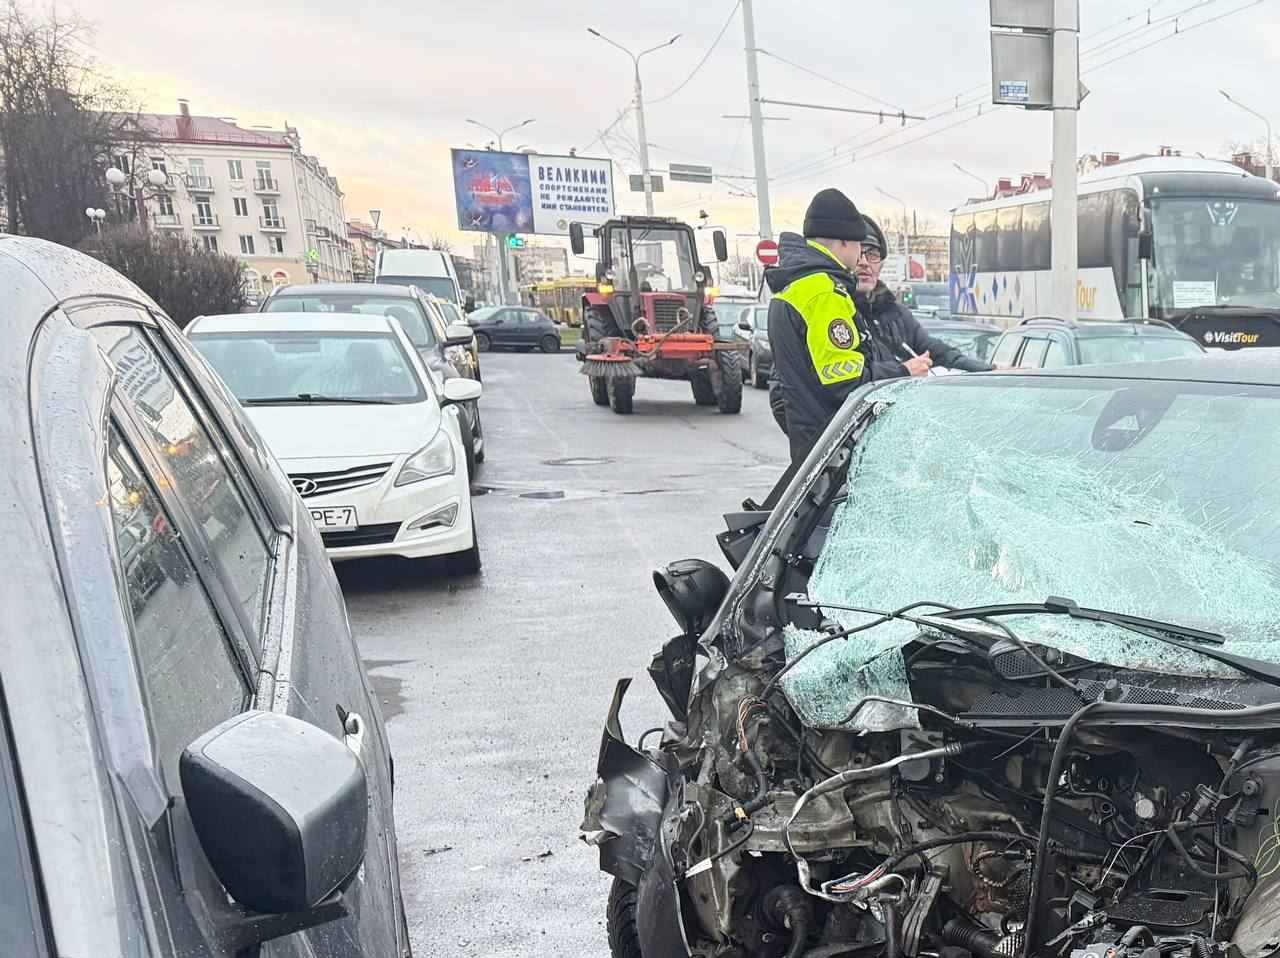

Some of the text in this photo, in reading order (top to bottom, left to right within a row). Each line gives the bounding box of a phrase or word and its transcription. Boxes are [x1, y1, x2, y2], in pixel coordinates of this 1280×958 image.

[538, 166, 606, 185] ВЕЛИКИМИ
[539, 183, 607, 194] СПОРТСМЕНАМИ
[540, 193, 550, 201] НЕ
[1213, 331, 1259, 343] VisitTour
